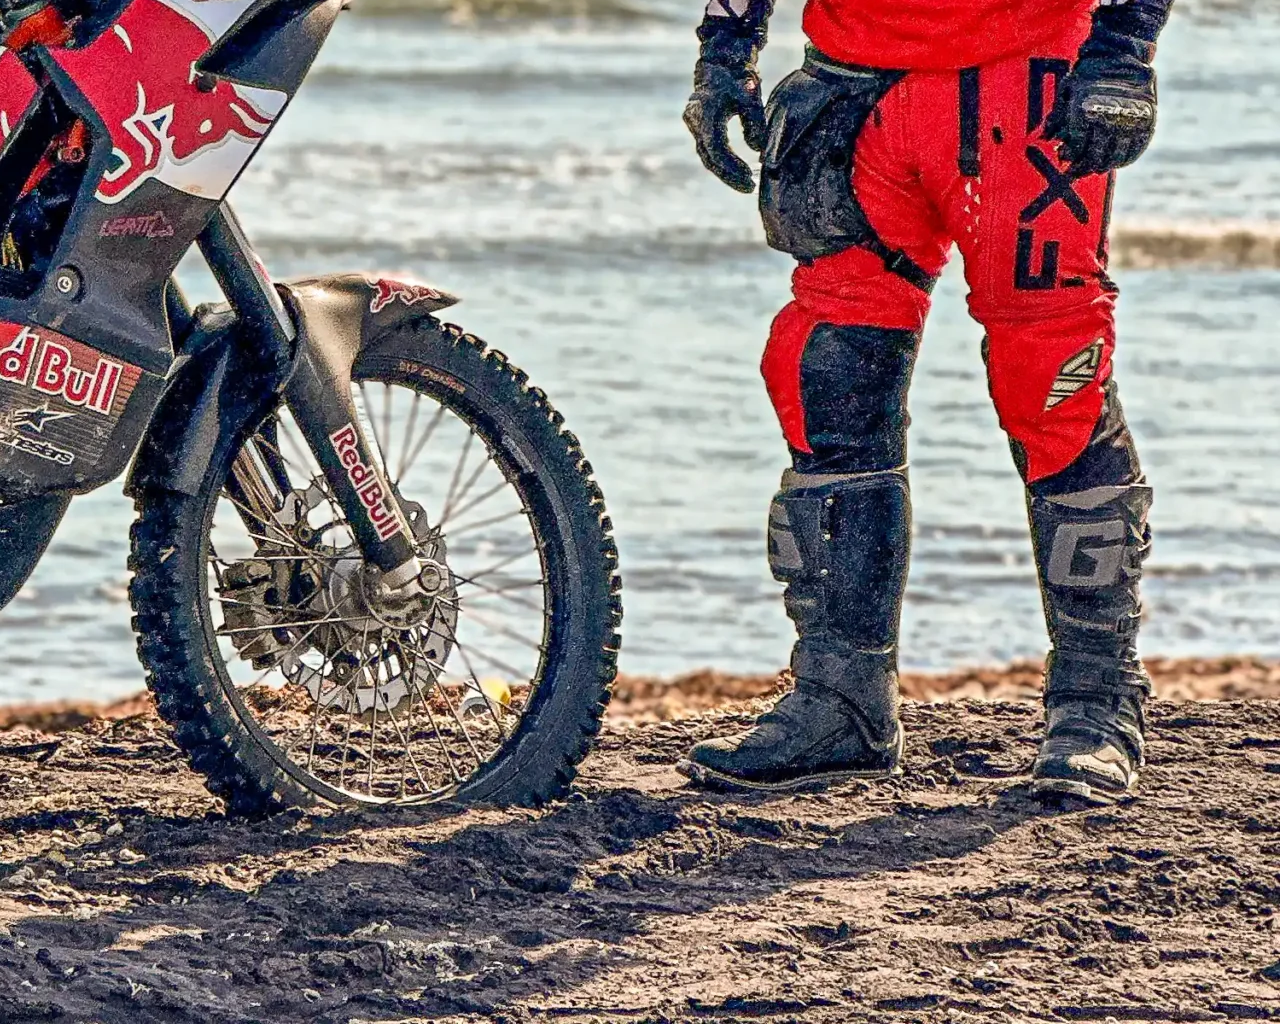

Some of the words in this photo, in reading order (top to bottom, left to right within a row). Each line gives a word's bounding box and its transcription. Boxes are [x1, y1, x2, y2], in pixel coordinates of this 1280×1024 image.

[32, 340, 123, 416] Bull
[329, 422, 376, 490] Red
[356, 476, 403, 542] Bull
